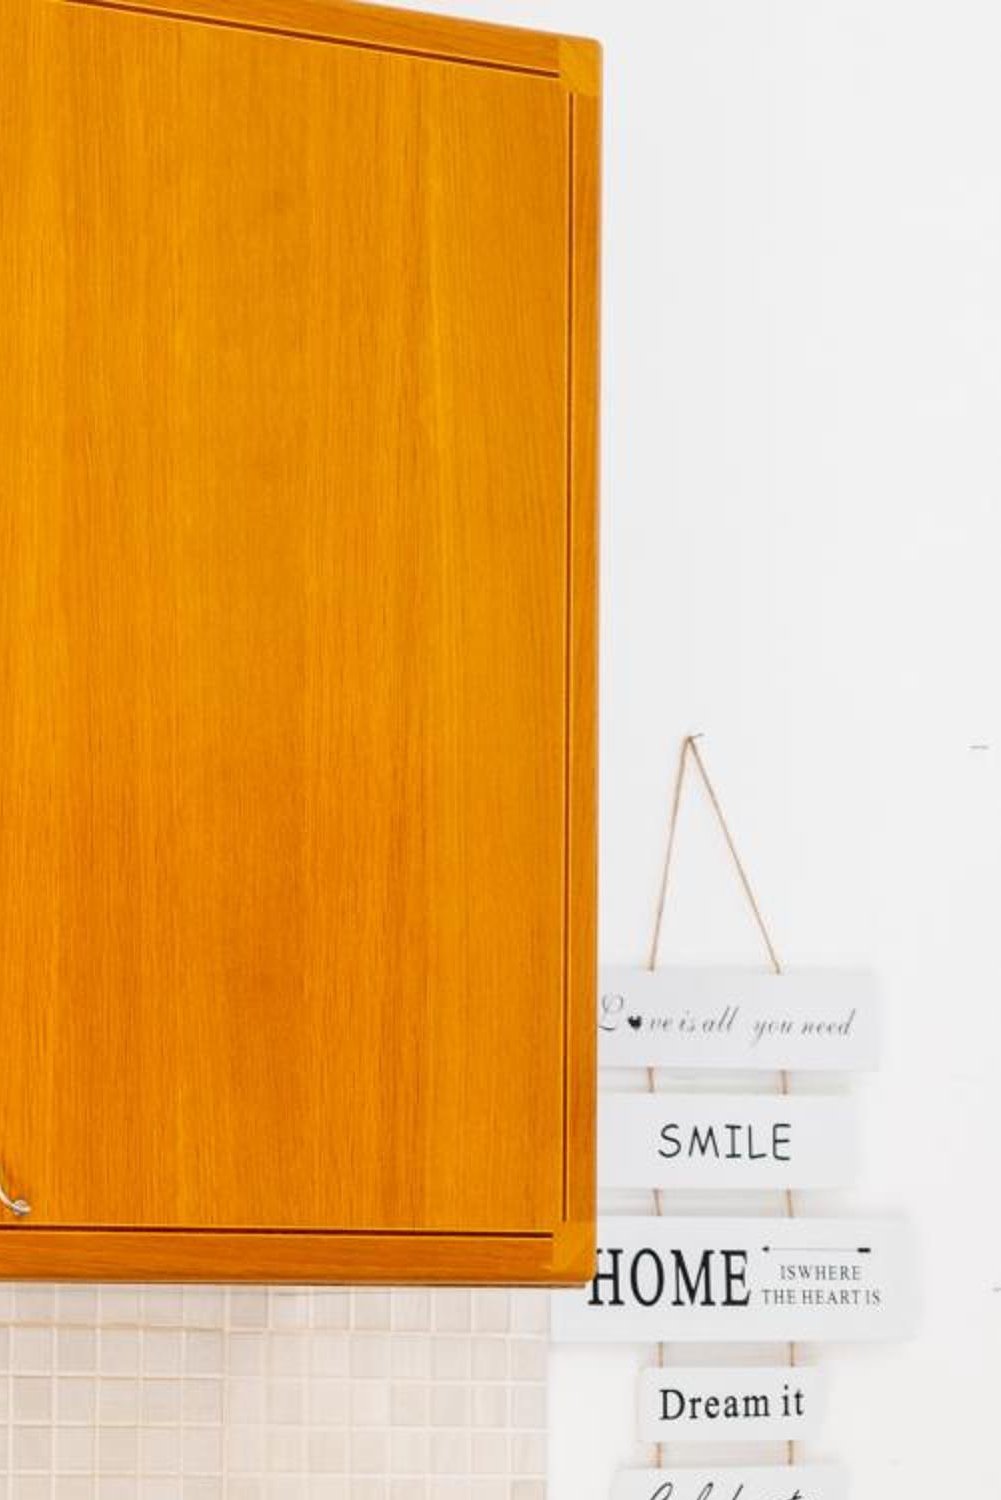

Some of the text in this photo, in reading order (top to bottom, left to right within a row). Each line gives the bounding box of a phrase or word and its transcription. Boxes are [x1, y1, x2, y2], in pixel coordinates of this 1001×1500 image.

[700, 1005, 740, 1032] all
[750, 1019, 794, 1047] you
[801, 1007, 856, 1034] need
[657, 1122, 792, 1161] SMILE
[588, 1247, 752, 1307] HOME
[761, 1287, 882, 1306] THE HEART IS
[658, 1384, 805, 1421] Dream it
